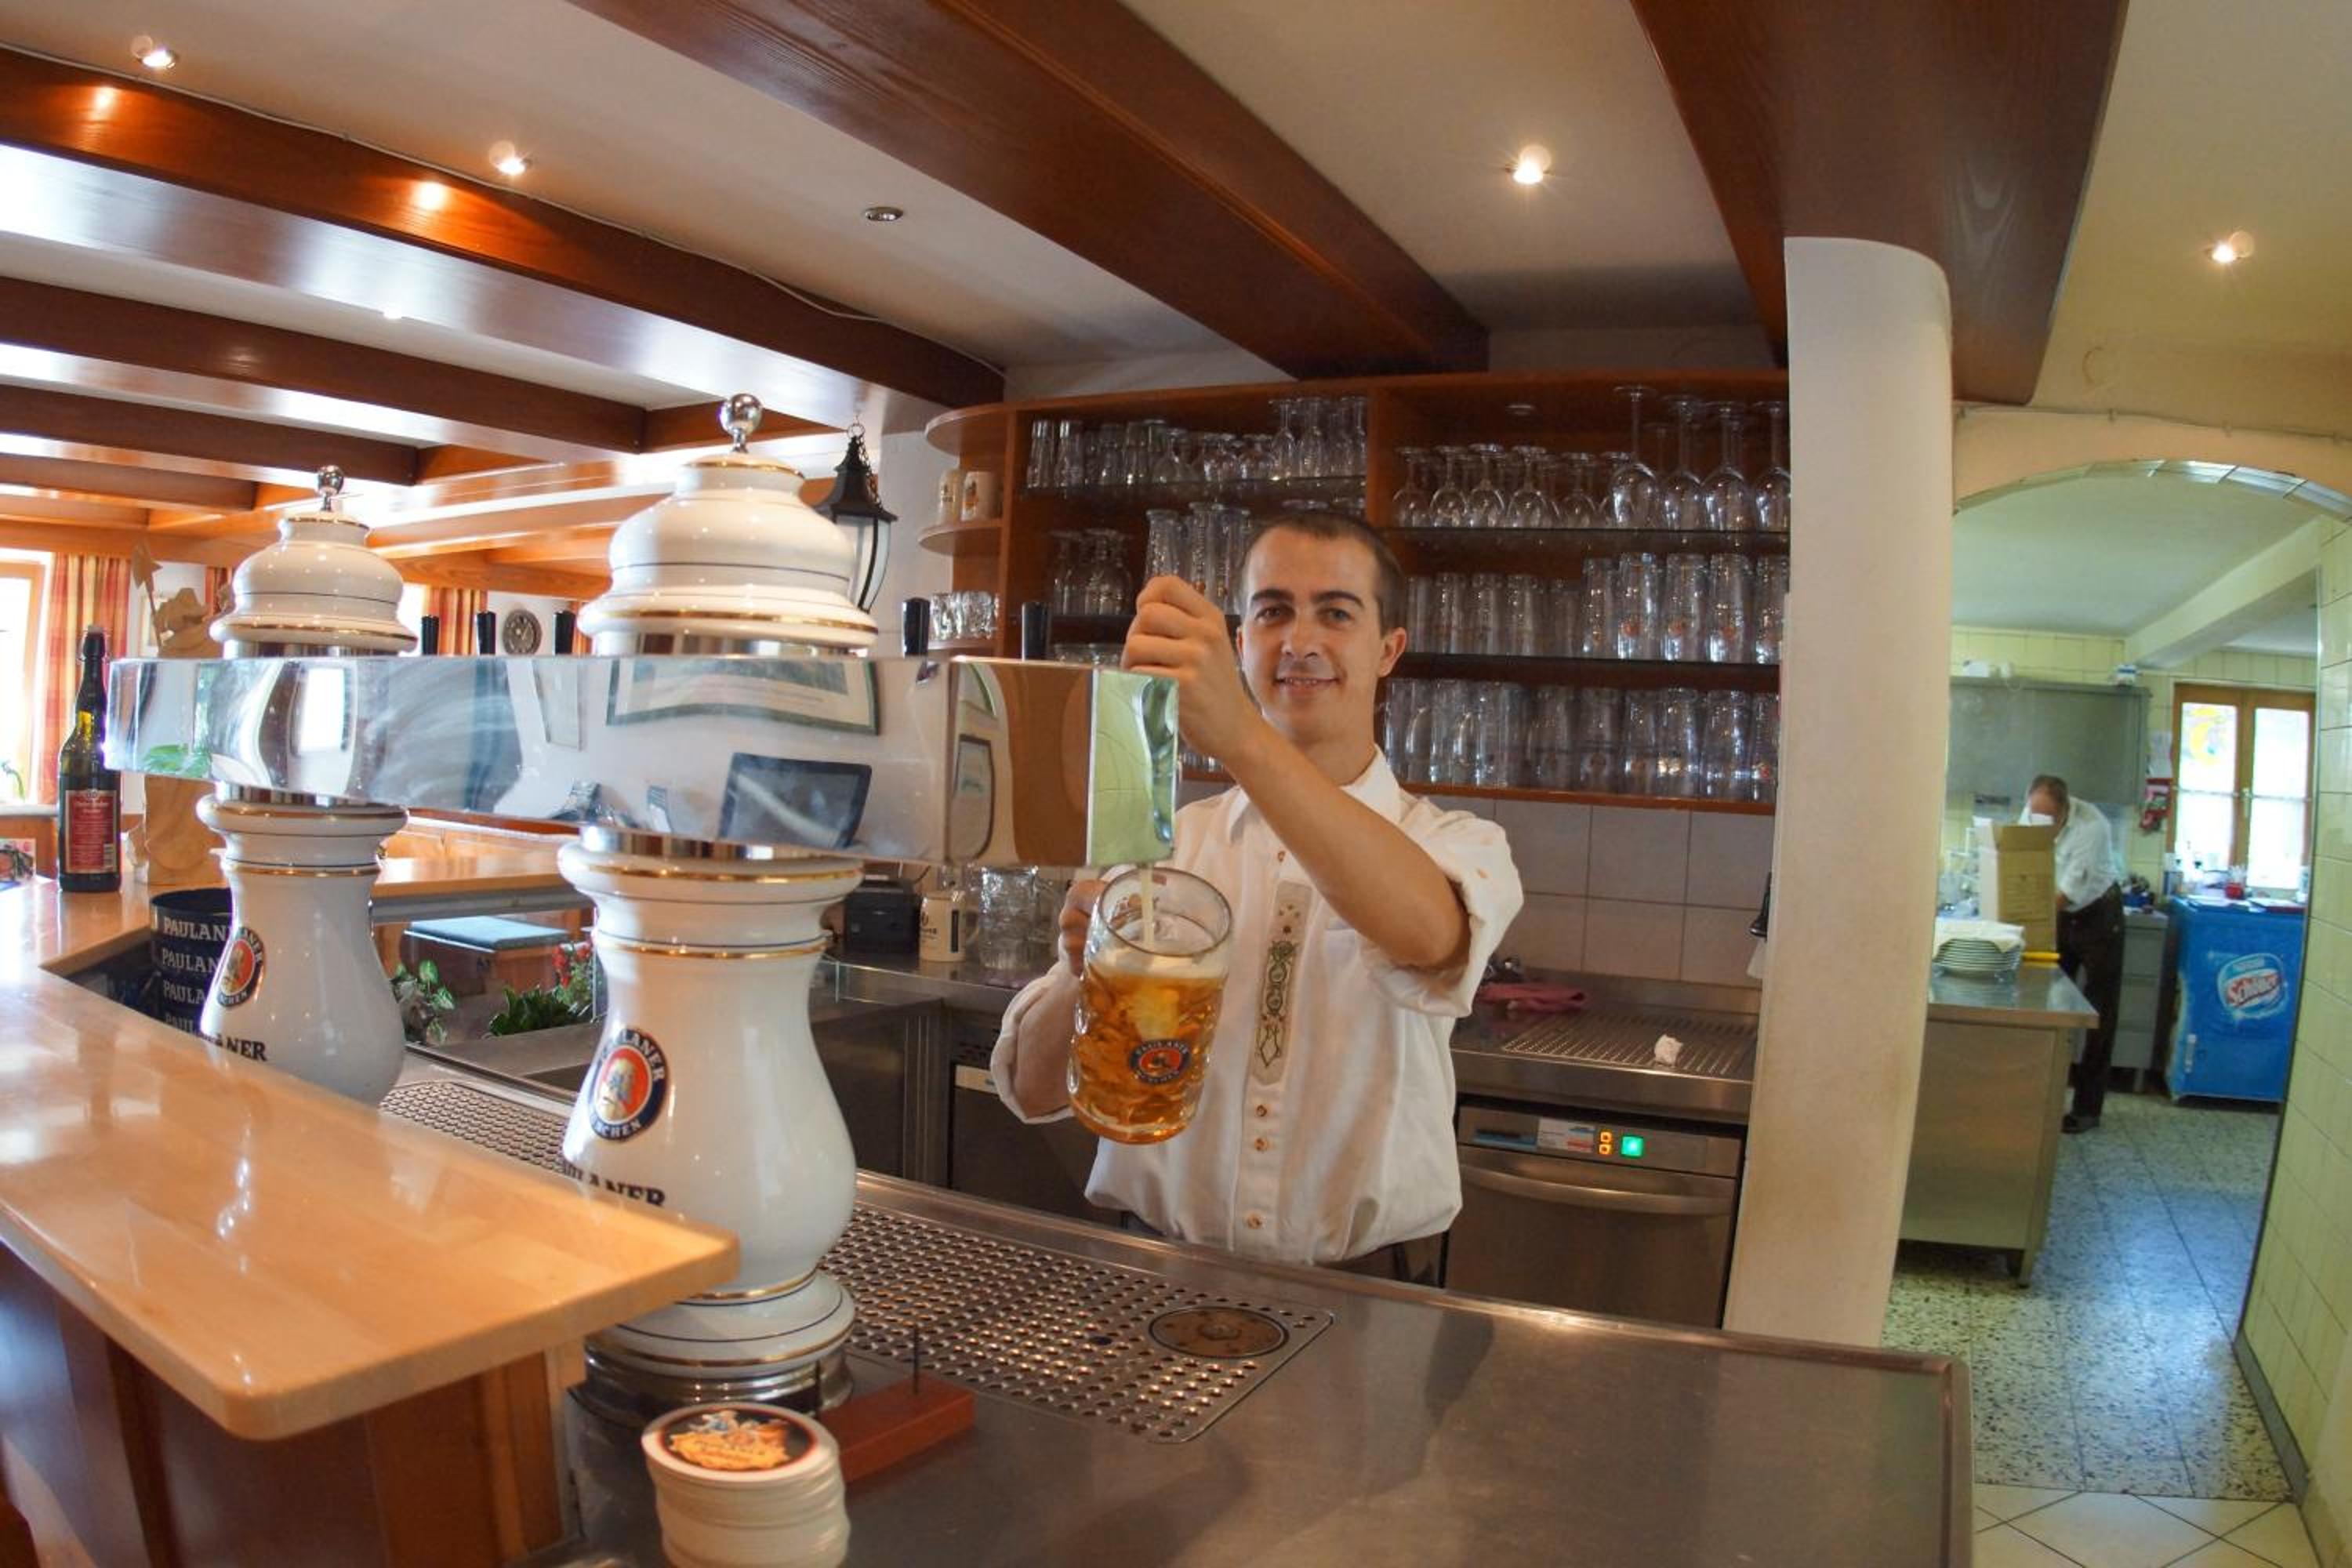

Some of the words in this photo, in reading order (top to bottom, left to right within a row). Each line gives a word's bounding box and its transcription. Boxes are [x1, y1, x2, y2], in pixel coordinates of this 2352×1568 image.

[163, 916, 228, 942] PAULAN
[162, 947, 219, 973] PAULAN
[163, 980, 205, 1004] PAULA
[606, 1029, 666, 1080] LANER
[593, 1116, 642, 1138] CHEN
